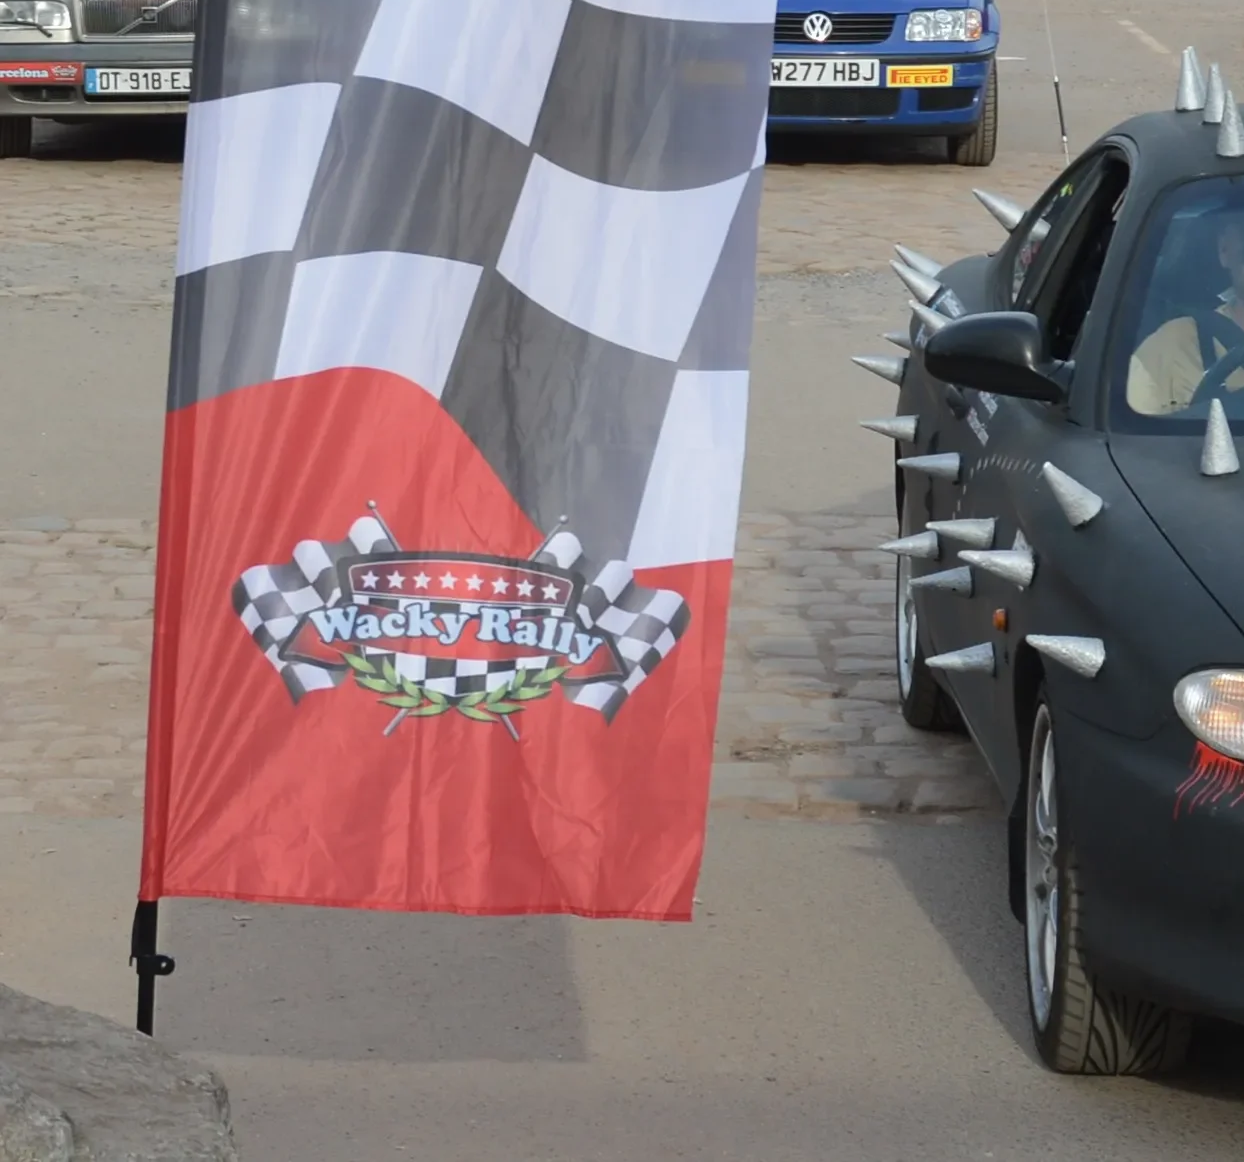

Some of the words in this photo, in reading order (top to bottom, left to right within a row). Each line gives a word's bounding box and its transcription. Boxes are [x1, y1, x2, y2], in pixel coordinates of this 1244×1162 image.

[833, 61, 875, 82] HBJ
[914, 74, 948, 84] EYED
[308, 602, 471, 646] Wacky
[476, 605, 604, 666] Rally
